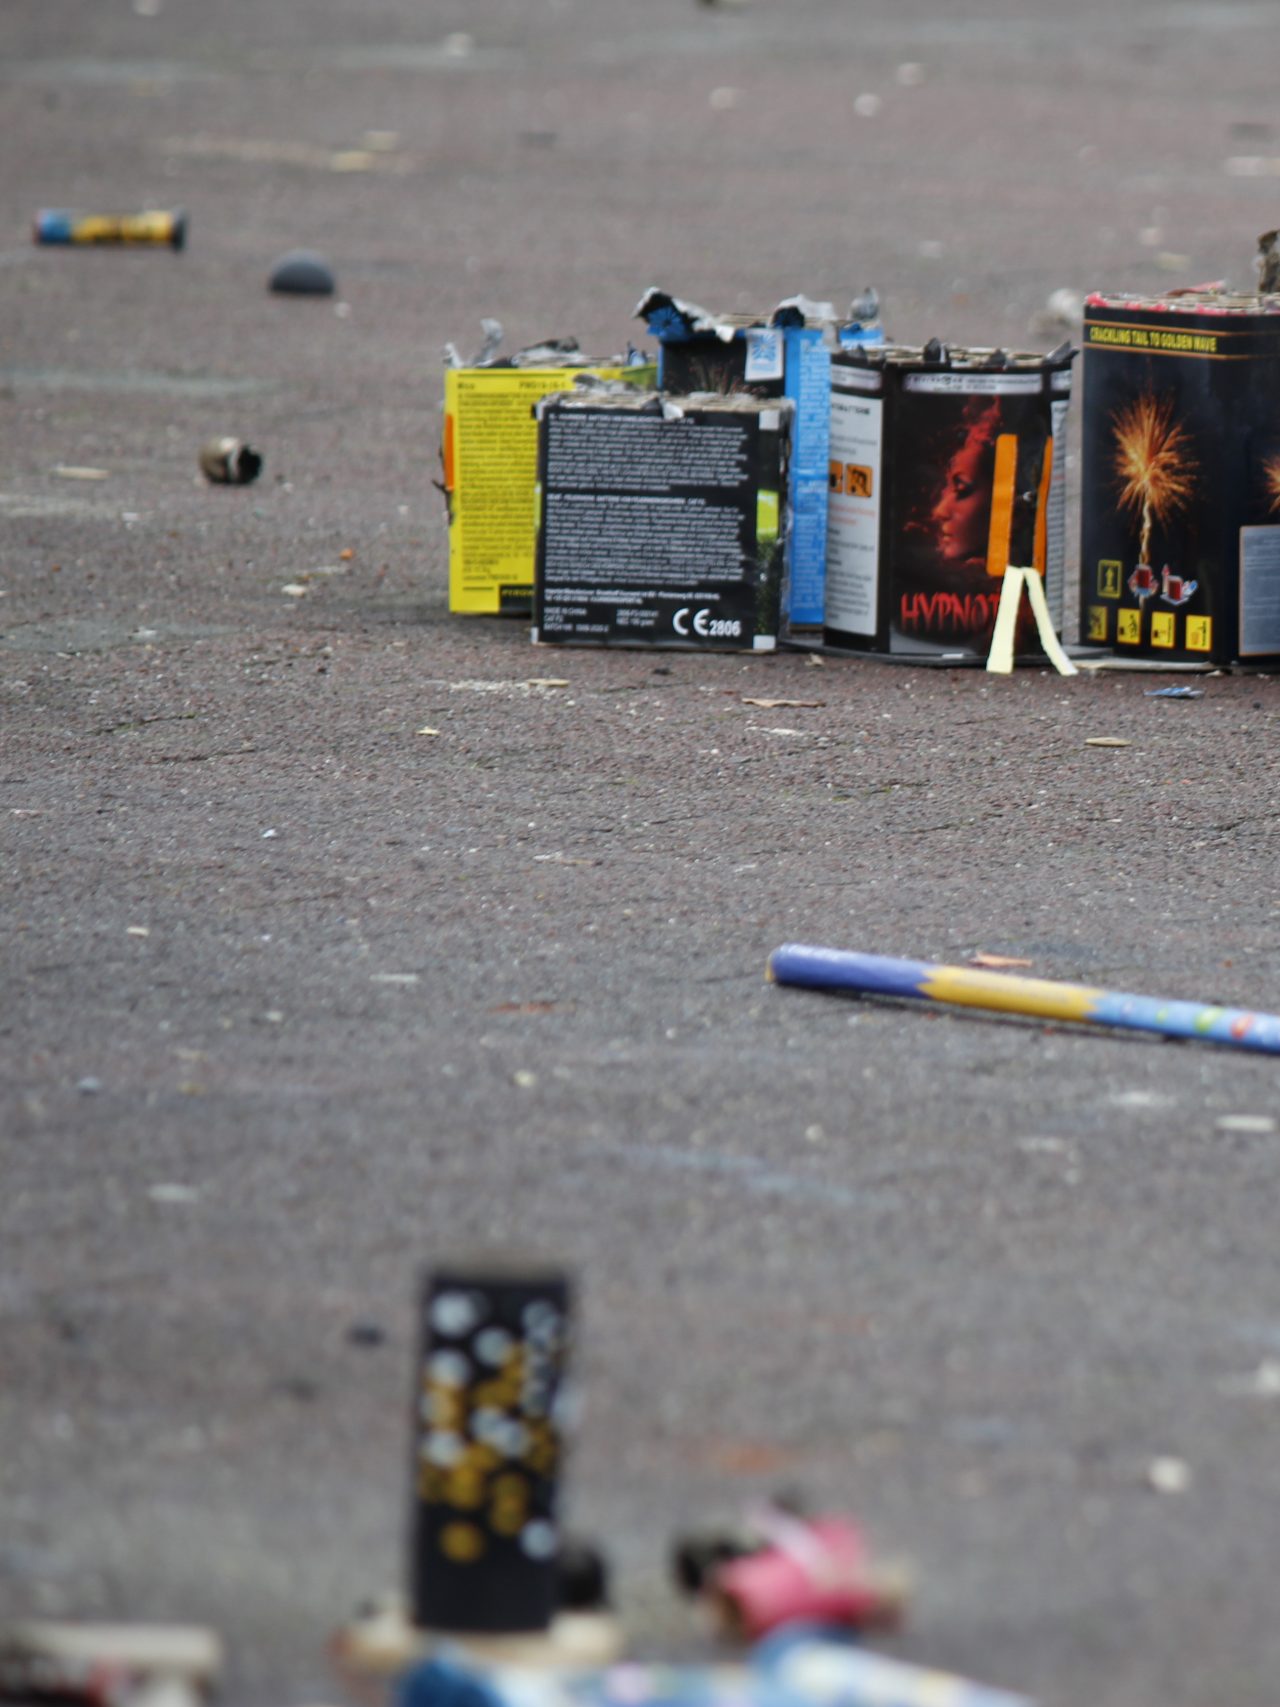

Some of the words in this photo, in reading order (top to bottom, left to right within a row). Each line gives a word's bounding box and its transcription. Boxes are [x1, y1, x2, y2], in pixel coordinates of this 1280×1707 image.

[1090, 327, 1131, 344] CRACKLING
[1132, 330, 1149, 346] TAIL
[1150, 332, 1161, 347] TO
[1161, 333, 1193, 350] GOLDEN
[1194, 336, 1217, 353] WAVE
[709, 619, 741, 637] 2806
